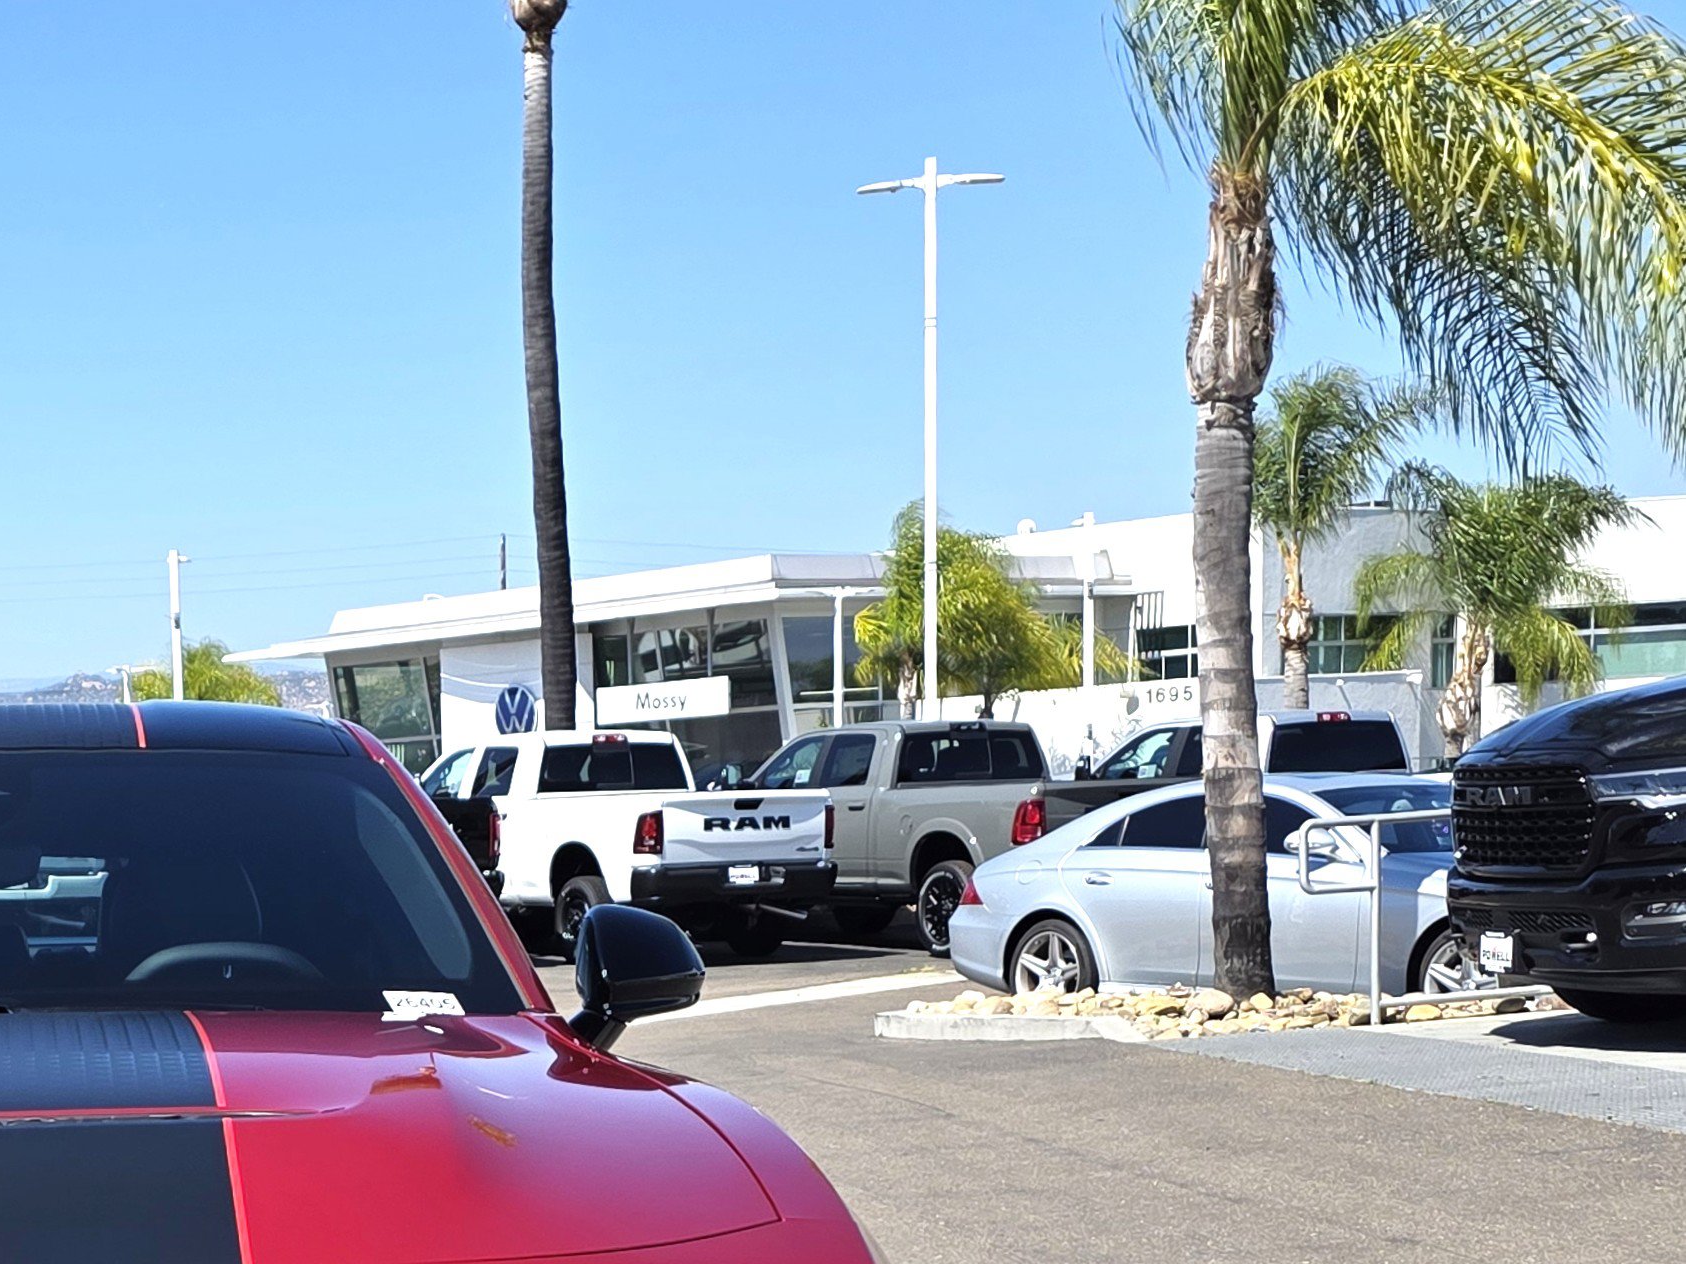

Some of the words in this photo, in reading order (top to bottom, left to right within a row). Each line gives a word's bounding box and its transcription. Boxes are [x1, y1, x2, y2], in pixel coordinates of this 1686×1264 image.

[635, 692, 687, 712] Mossy
[1146, 686, 1193, 703] 1695
[1465, 786, 1532, 806] RAM
[704, 816, 791, 831] RAM
